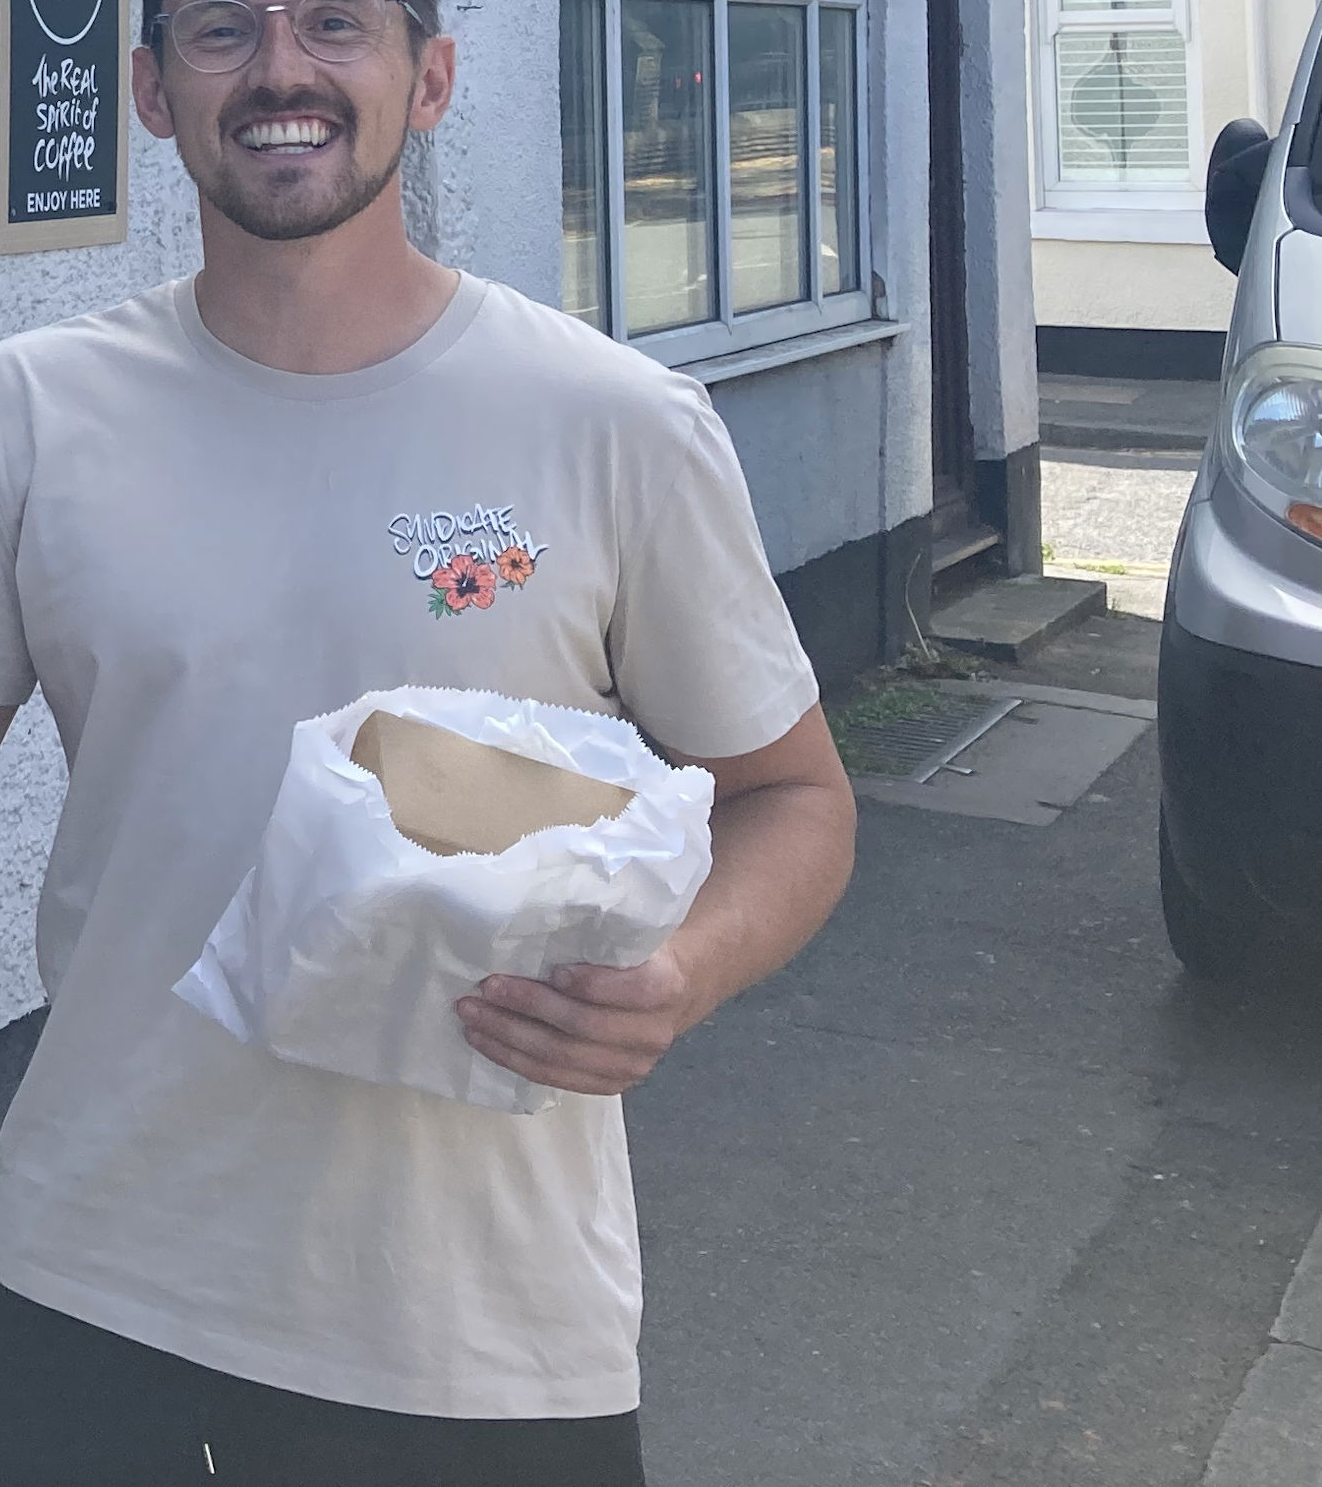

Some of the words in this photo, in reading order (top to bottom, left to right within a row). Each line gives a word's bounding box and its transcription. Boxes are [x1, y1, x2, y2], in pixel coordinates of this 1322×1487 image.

[82, 96, 100, 133] of
[27, 190, 68, 213] ENJOY
[70, 188, 101, 210] HERE
[388, 503, 517, 556] SYNDICATE
